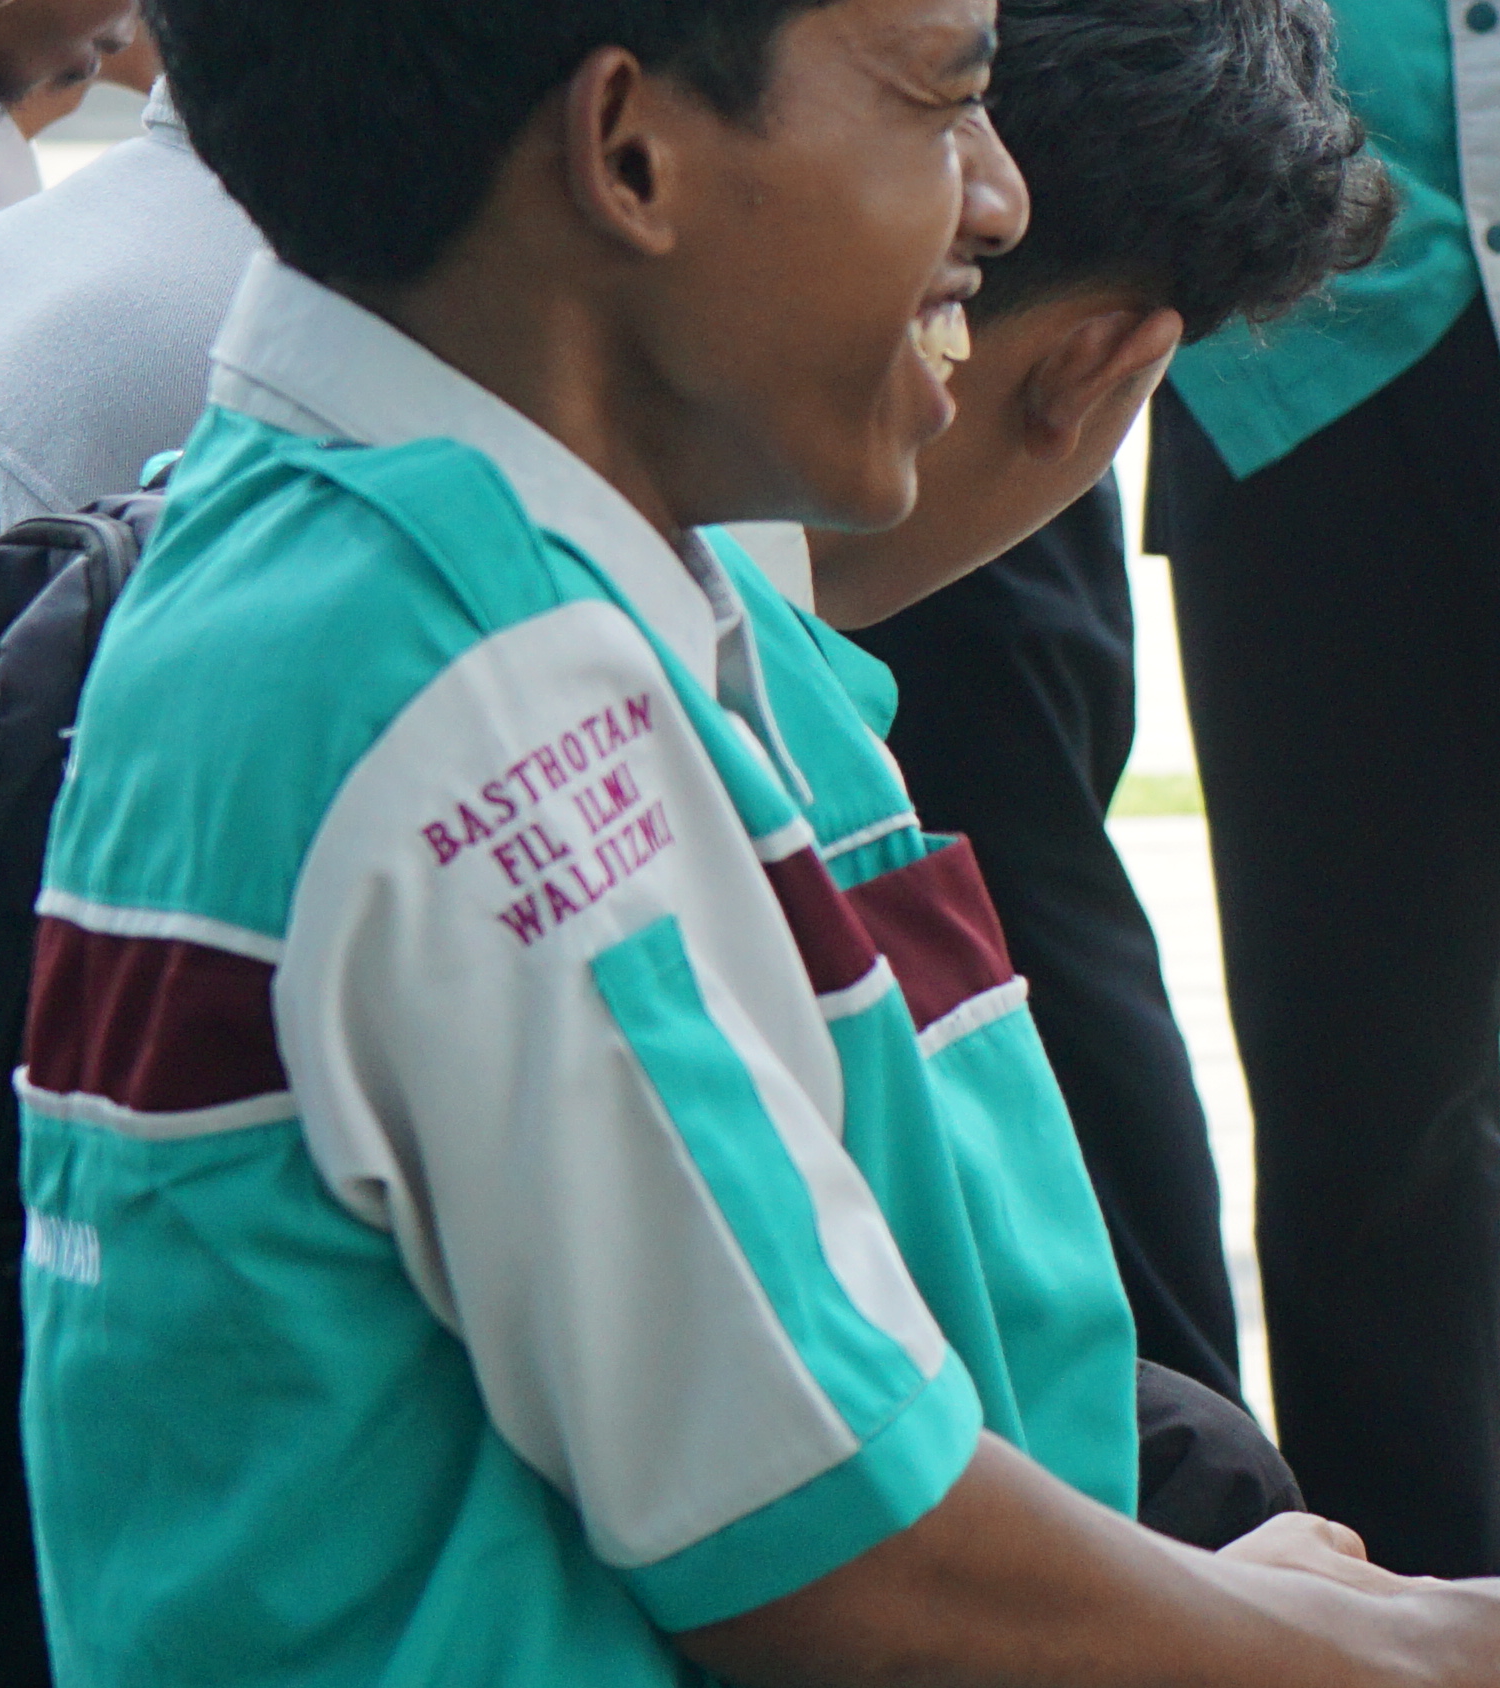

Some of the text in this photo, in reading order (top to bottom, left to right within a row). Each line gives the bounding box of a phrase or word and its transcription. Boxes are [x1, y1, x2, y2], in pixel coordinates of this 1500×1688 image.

[422, 692, 652, 865] BASTHOTAN
[491, 761, 641, 886] FIL ILMI
